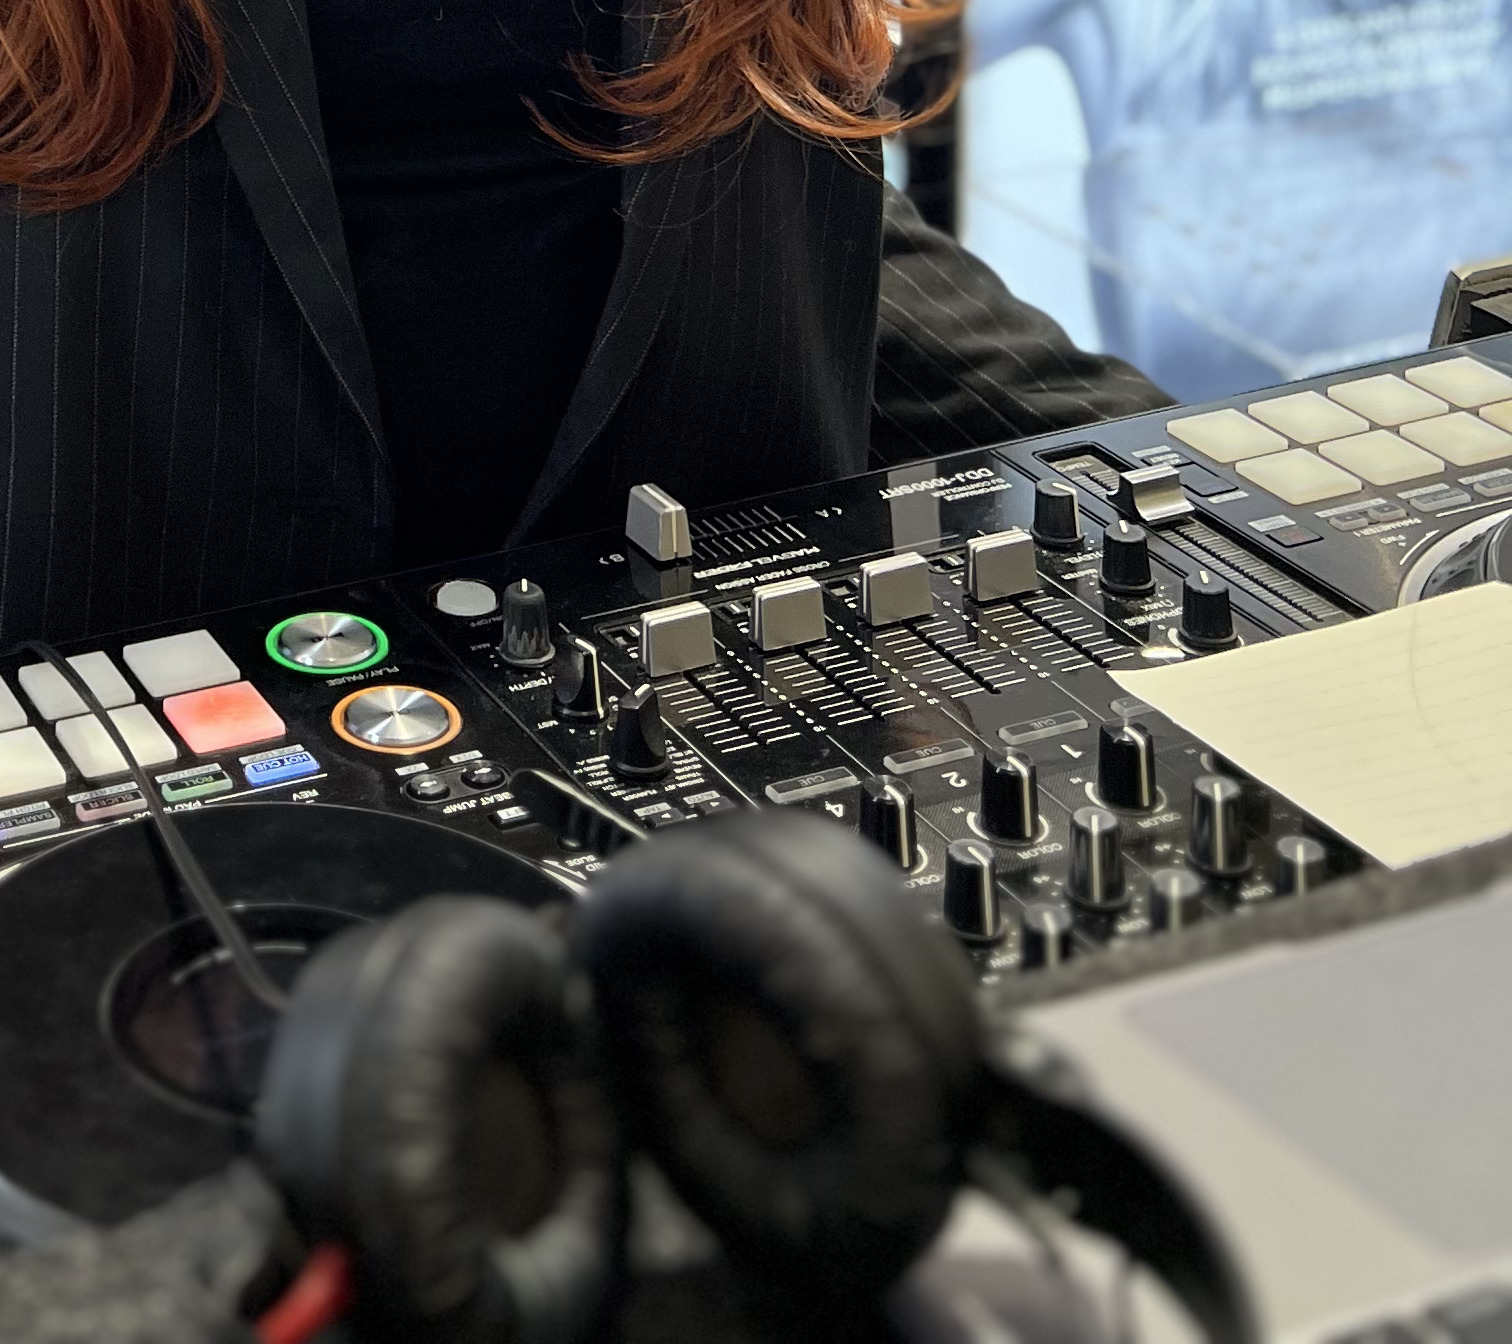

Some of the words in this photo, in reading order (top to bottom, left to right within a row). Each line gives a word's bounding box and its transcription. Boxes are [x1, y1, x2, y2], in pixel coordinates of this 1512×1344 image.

[879, 468, 994, 500] DDJ-1000SRT
[1032, 717, 1056, 730] CUE
[916, 745, 942, 758] CUE
[287, 753, 310, 767] HOT
[180, 774, 215, 787] ROLL
[800, 775, 824, 787] CUE
[941, 771, 968, 788] 2
[90, 793, 135, 809] SLICER
[292, 788, 319, 801] REV
[479, 791, 514, 807] BEAT
[442, 798, 477, 814] JUMP
[824, 800, 843, 817] 4
[1138, 812, 1182, 829] COLOR
[1017, 843, 1062, 861] COLOR
